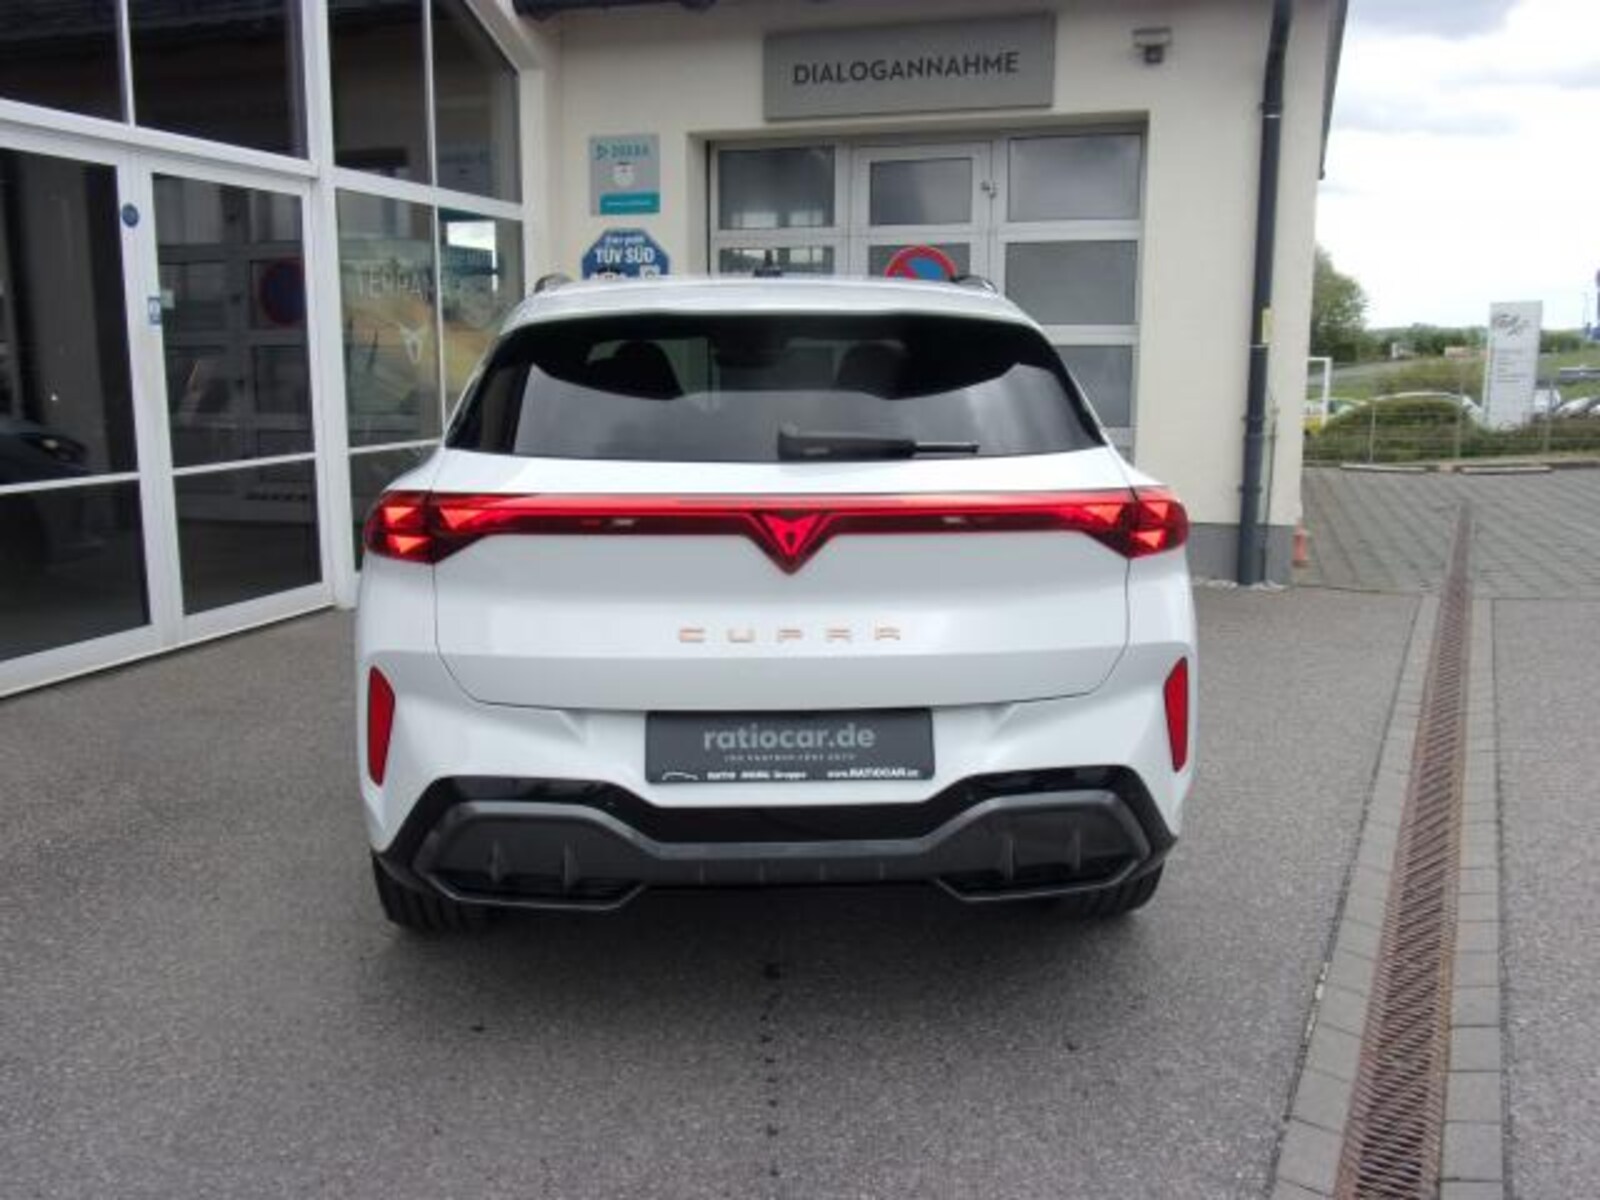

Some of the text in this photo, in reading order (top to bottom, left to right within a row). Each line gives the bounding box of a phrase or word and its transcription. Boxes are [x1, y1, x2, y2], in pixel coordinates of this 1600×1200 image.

[793, 51, 1020, 85] DIALOGANNAHME
[679, 627, 901, 643] CUPRA
[703, 722, 876, 751] ratiocar.de
